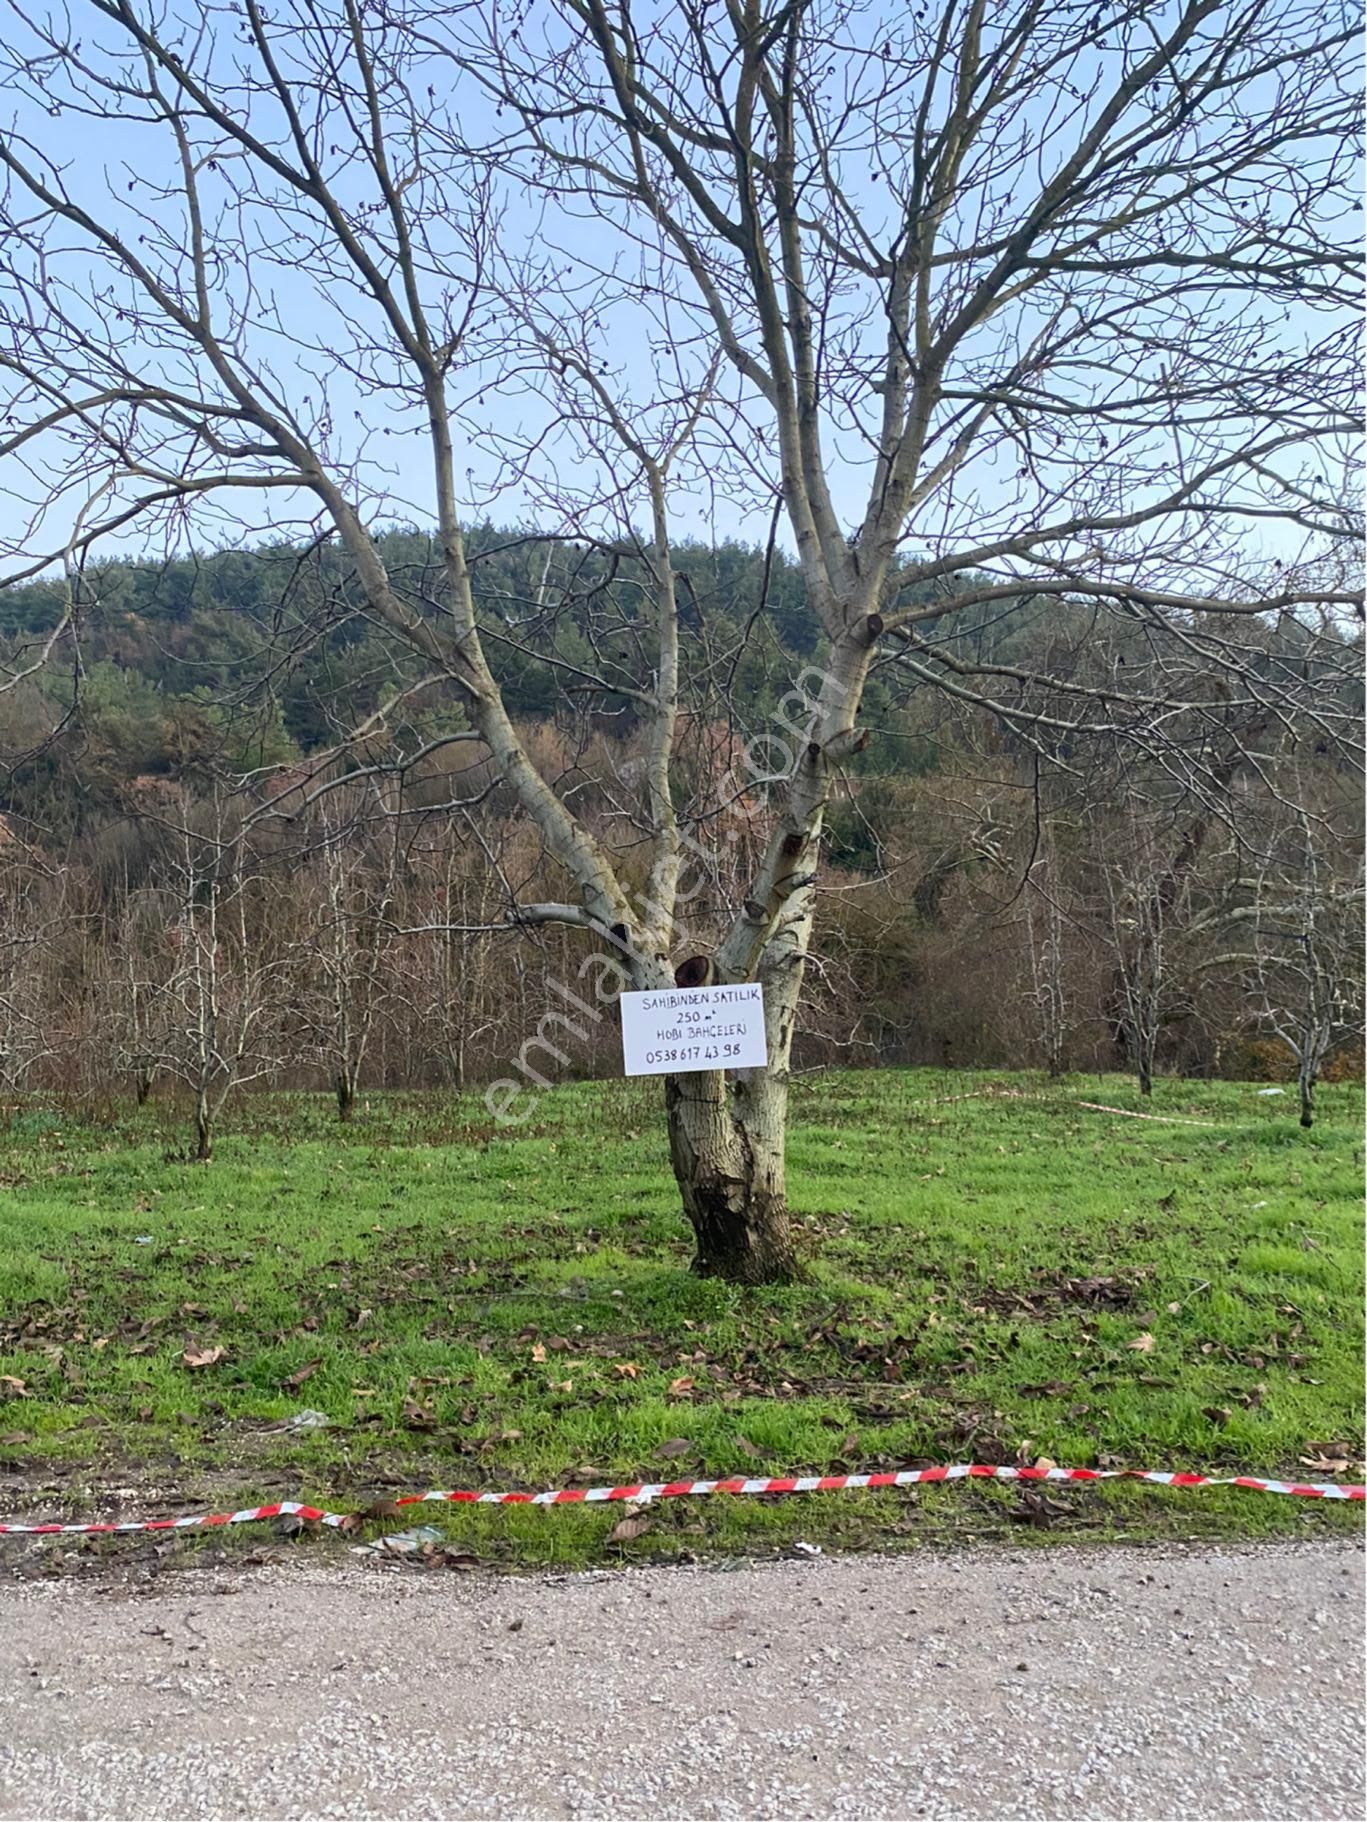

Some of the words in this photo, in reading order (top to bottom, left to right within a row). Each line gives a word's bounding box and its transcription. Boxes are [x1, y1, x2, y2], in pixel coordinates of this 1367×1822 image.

[712, 988, 760, 1003] SATILIK
[676, 1011, 700, 1023] 250
[705, 1045, 719, 1059] 43
[723, 1043, 741, 1057] 98
